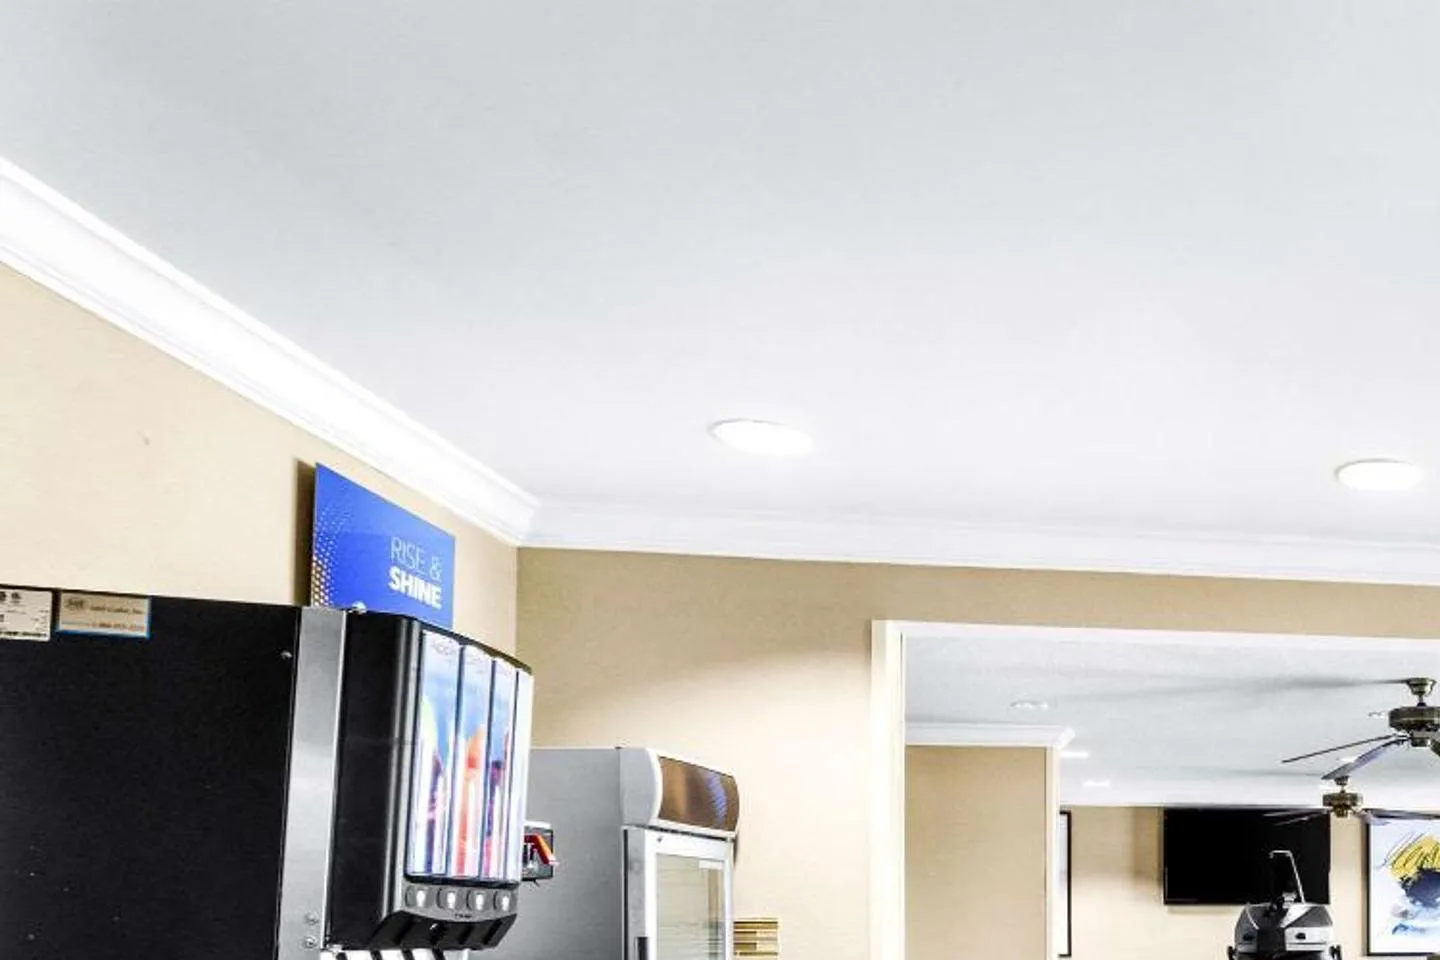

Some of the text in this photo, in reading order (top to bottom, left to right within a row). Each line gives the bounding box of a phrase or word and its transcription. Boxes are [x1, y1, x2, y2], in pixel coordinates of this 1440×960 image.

[391, 536, 442, 582] RISE &
[388, 566, 442, 609] SHINE
